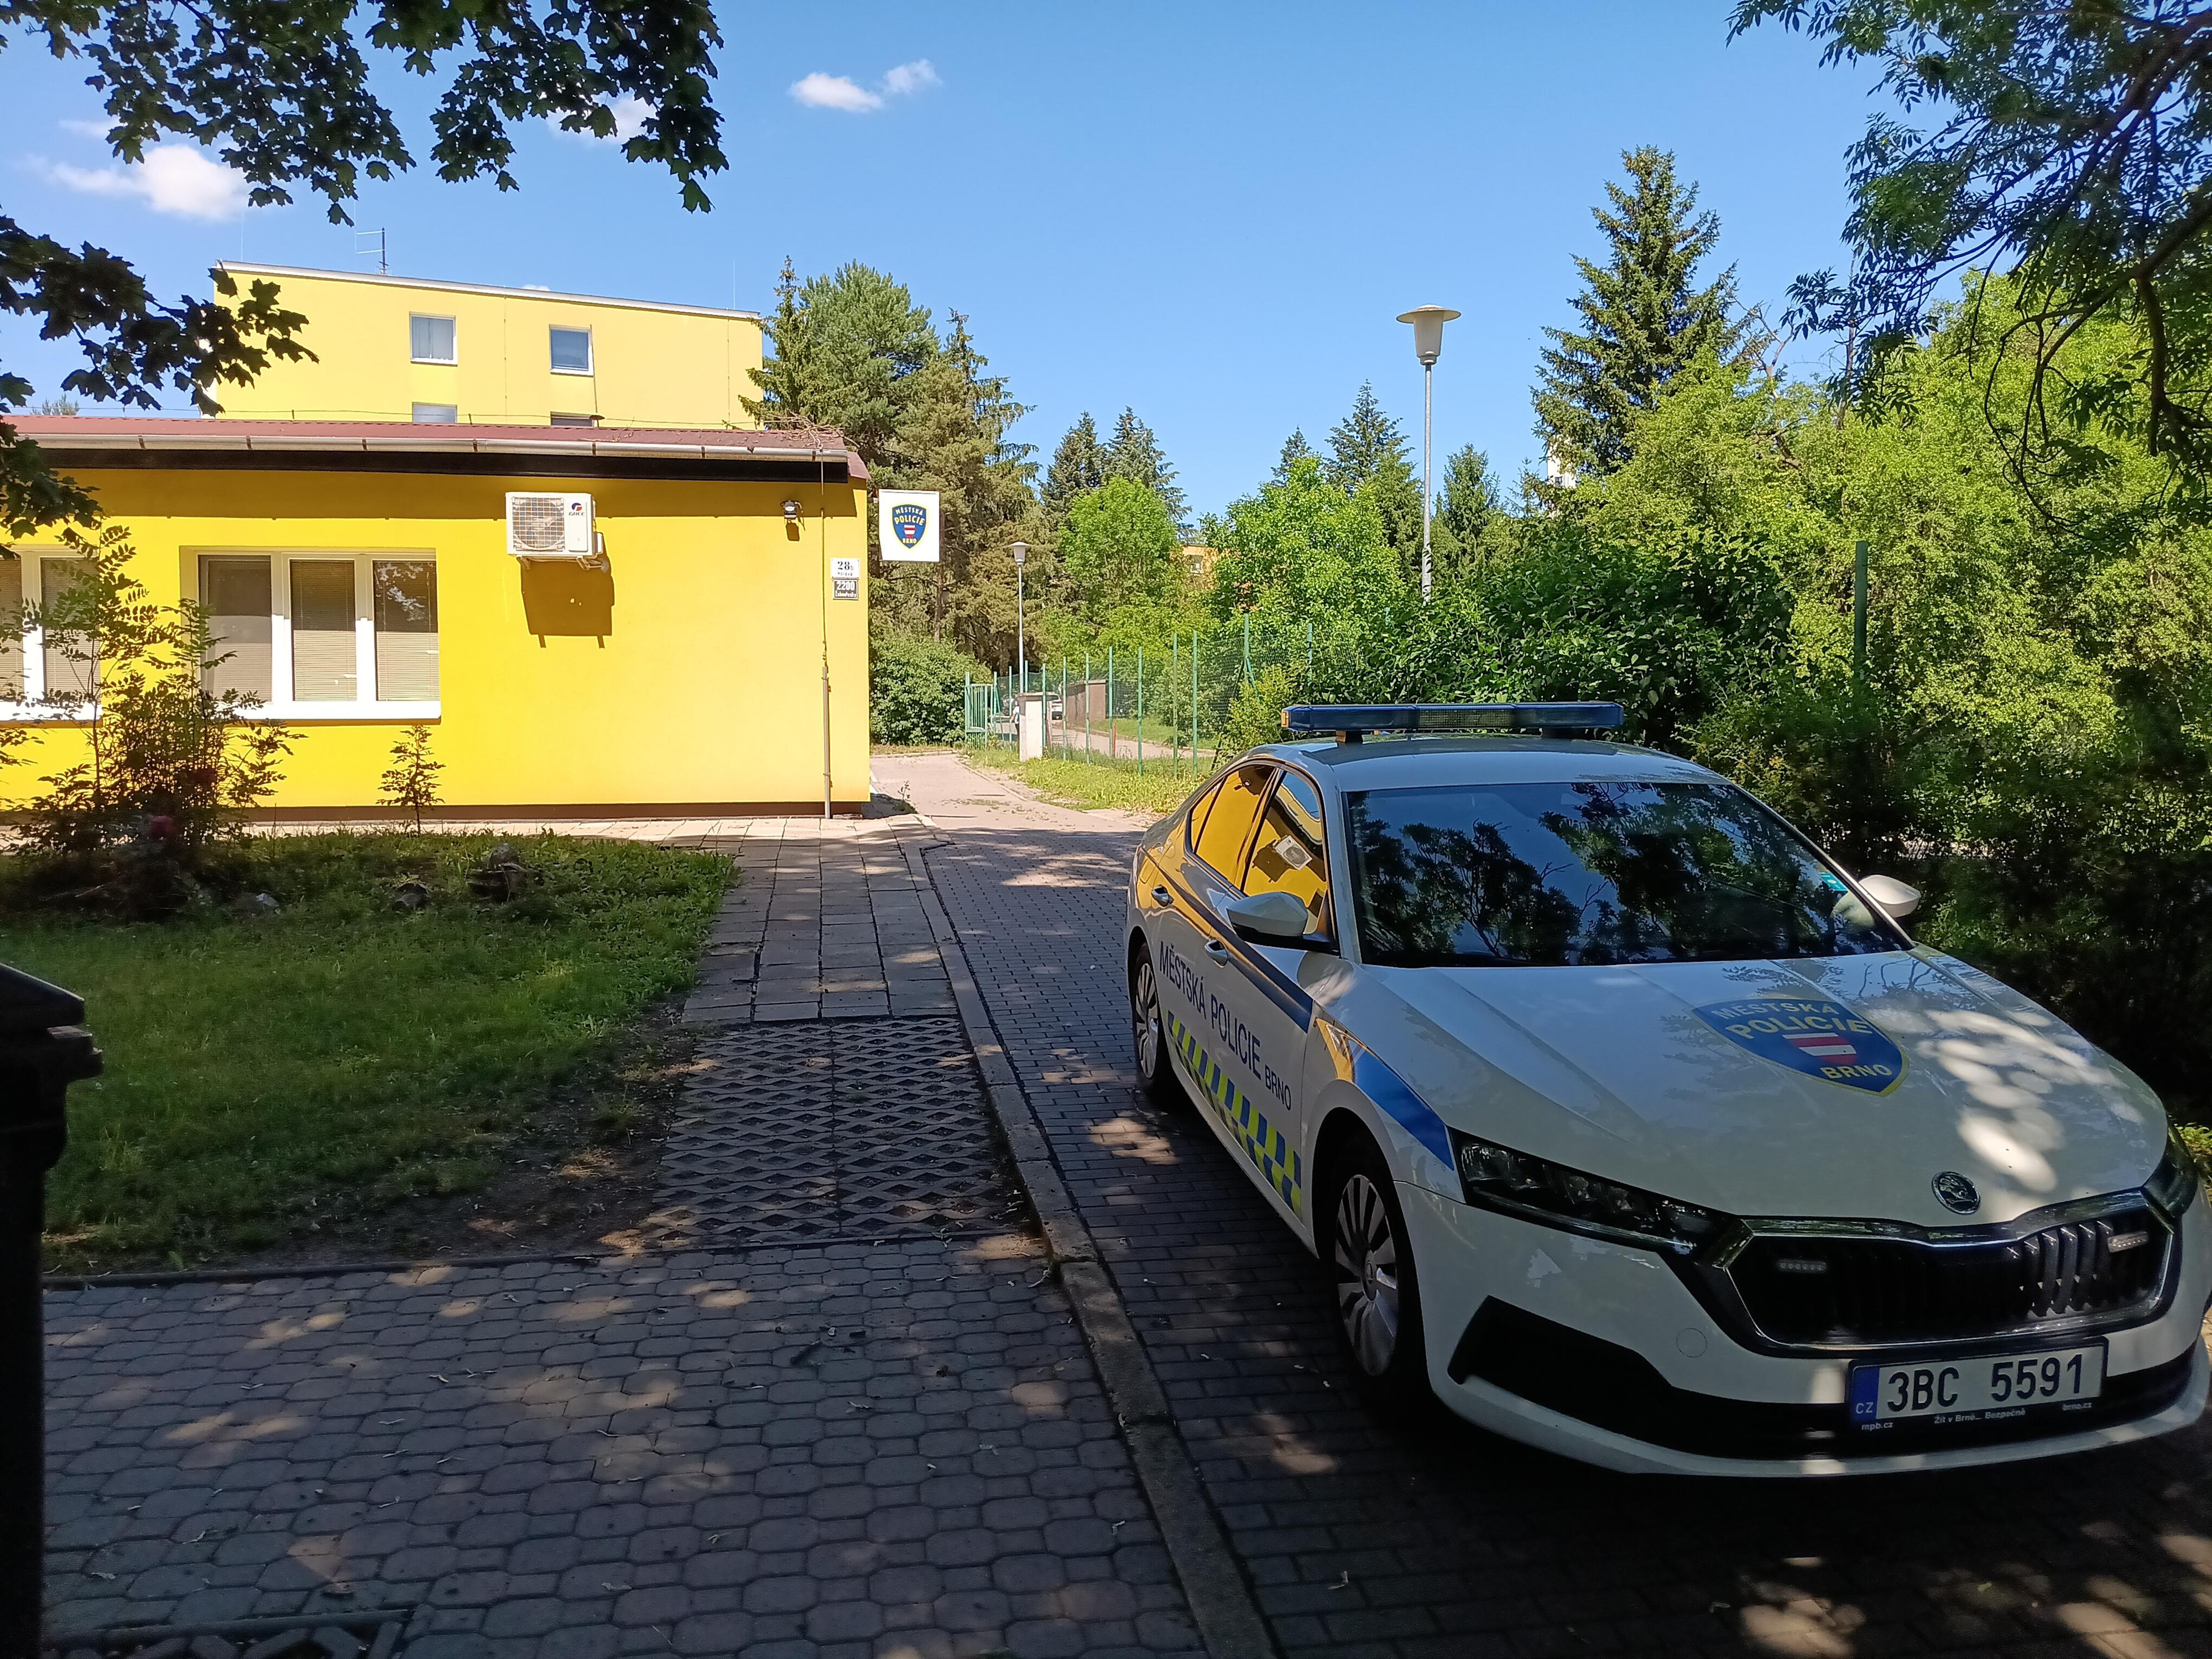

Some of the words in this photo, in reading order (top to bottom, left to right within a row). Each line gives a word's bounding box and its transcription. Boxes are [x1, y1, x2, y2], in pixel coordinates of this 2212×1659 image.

[895, 507, 923, 515] MĚSTSKÁ
[894, 515, 925, 526] POLICIE
[836, 581, 855, 591] 2200
[1711, 1002, 1839, 1020] MĚSTSKÁ
[1160, 941, 1207, 1020] MĚSTSKÁ
[1211, 993, 1261, 1081] POLICIE
[1265, 1064, 1291, 1111] BRNO
[1725, 1015, 1875, 1040] POLICIE
[1820, 1064, 1893, 1079] BRNO
[1887, 1367, 1959, 1412] 3BC
[1991, 1354, 2083, 1402] 5591
[1856, 1402, 1874, 1414] CZ
[1861, 1422, 1893, 1431] mpb.cz
